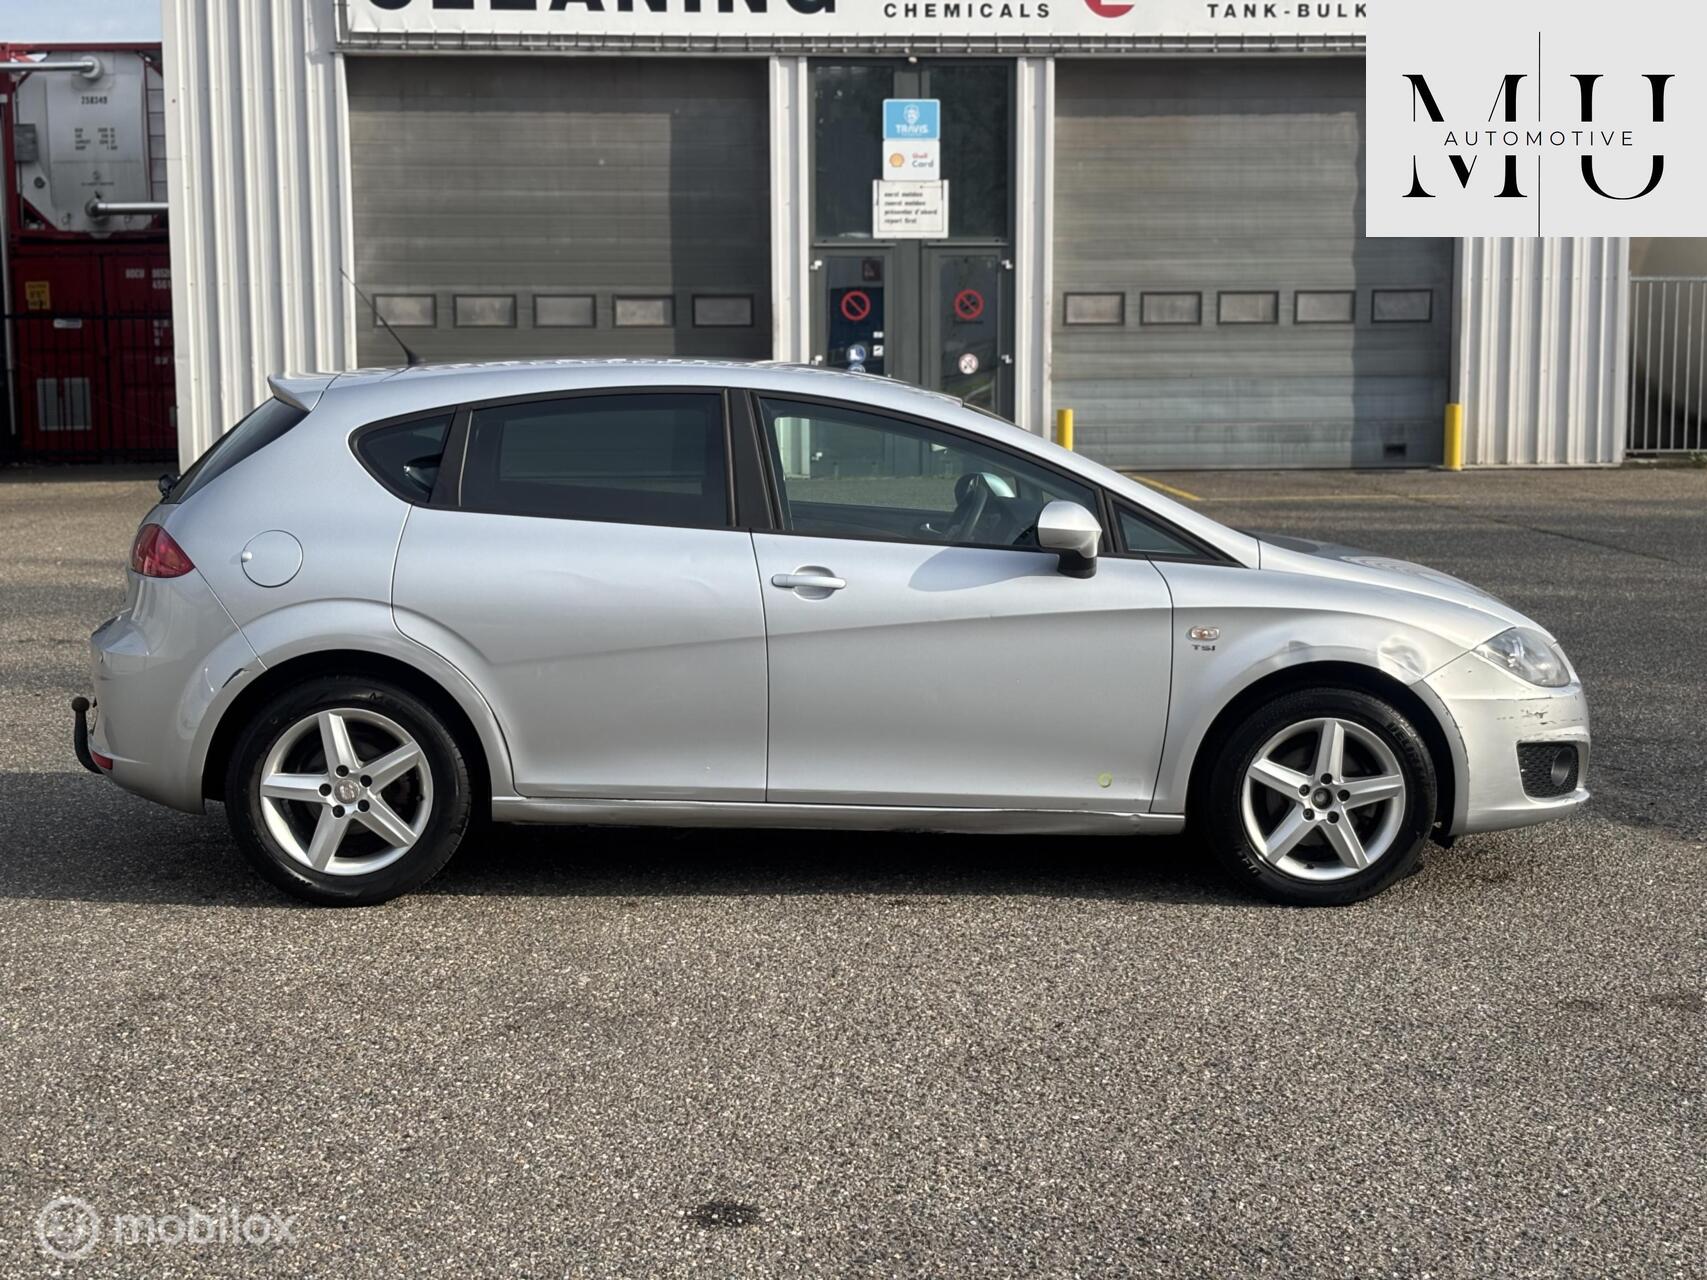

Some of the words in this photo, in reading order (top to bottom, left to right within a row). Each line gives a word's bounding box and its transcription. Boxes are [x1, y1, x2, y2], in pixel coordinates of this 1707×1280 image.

[883, 3, 1051, 18] CHEMICALS
[1207, 3, 1366, 18] TANK-BULK
[895, 124, 929, 134] TRAVIS
[911, 160, 934, 168] Card
